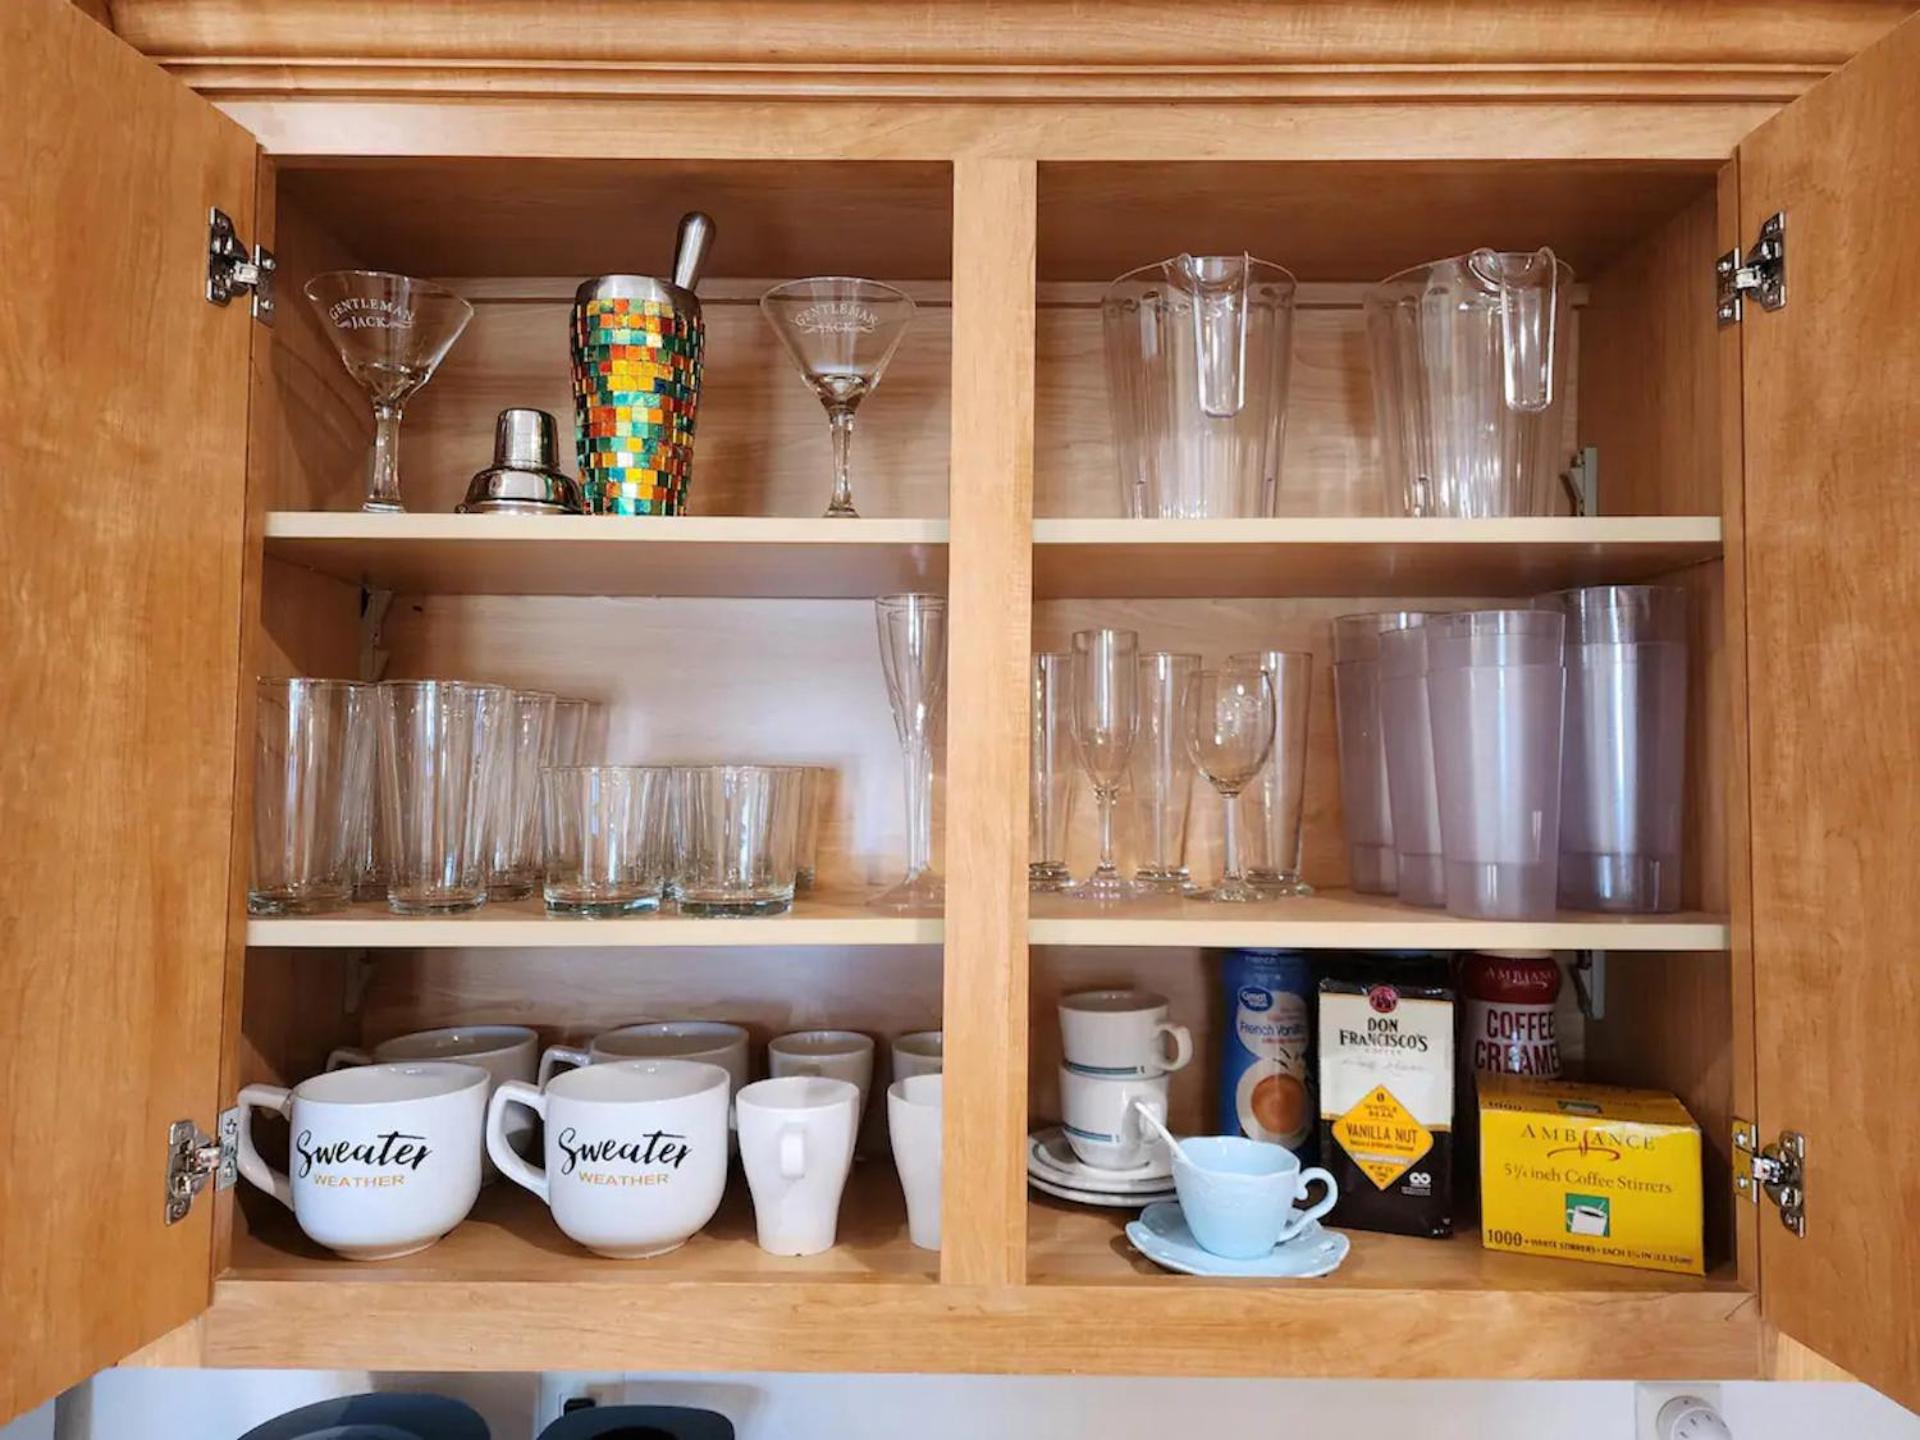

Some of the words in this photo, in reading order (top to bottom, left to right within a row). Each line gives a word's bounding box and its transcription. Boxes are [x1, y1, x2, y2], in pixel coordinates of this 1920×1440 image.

[328, 298, 414, 321] GENTLEMAN
[795, 303, 877, 326] GENTLEMAN
[351, 316, 388, 329] JACK
[1240, 1021, 1274, 1036] French
[1367, 1017, 1398, 1032] DON
[1487, 1009, 1555, 1040] COFFEE
[1340, 1029, 1428, 1052] FRANCISCO'S
[1346, 1122, 1391, 1141] VANILLA
[1395, 1127, 1418, 1145] NUT
[1521, 1123, 1656, 1153] AMBIANCE
[296, 1129, 433, 1178] Sweater
[558, 1127, 692, 1175] Sweater
[314, 1173, 405, 1188] WEATHER
[578, 1171, 669, 1186] WEATHER
[1530, 1167, 1561, 1183] inch
[1565, 1168, 1615, 1189] Coffee
[1617, 1176, 1673, 1195] Stirrers
[1487, 1228, 1523, 1248] 1000
